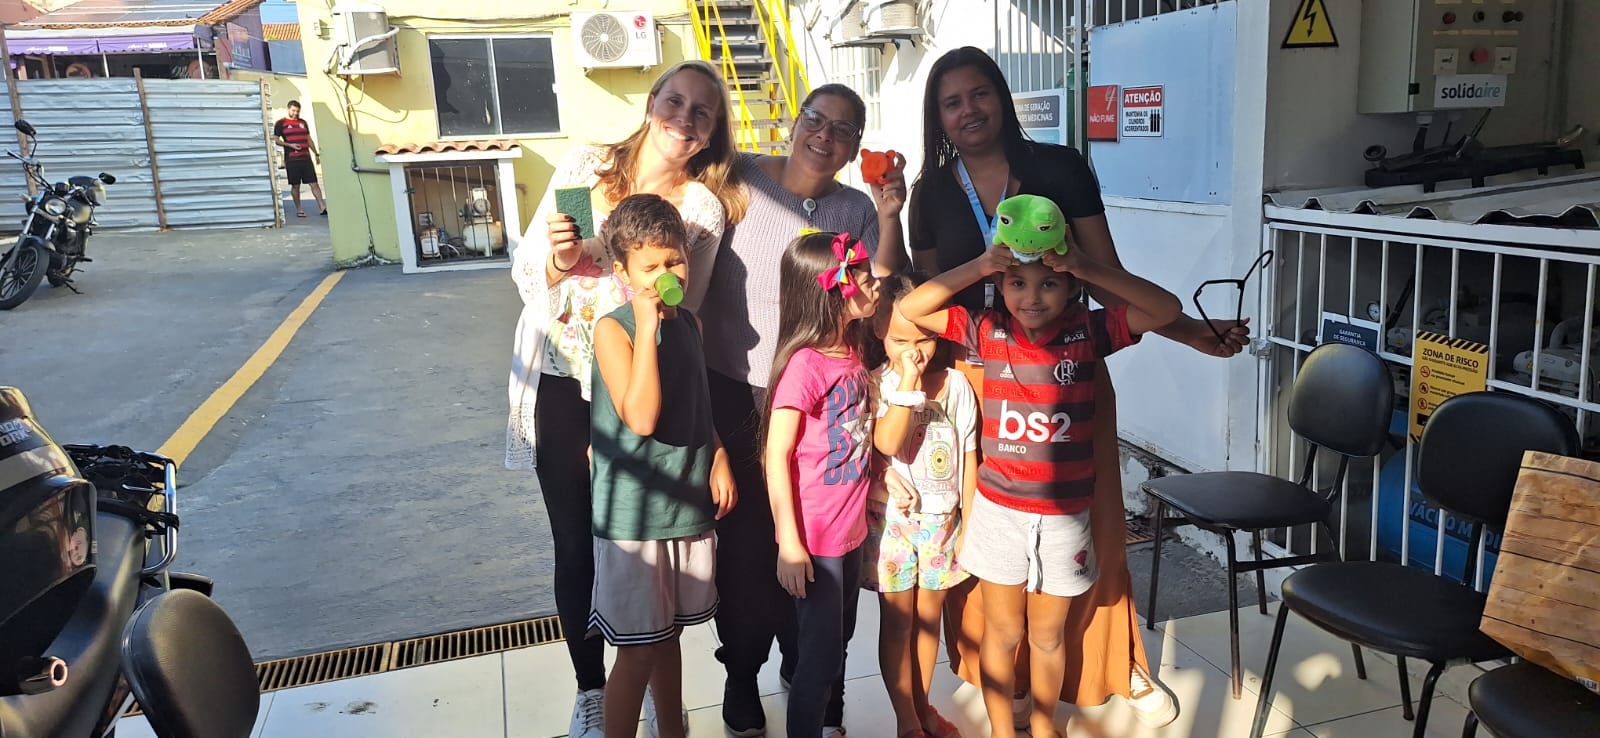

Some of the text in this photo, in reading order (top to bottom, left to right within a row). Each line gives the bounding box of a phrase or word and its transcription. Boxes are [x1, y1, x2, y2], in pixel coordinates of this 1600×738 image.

[635, 31, 647, 39] LG
[1441, 81, 1500, 99] solidaire
[1124, 91, 1161, 104] ATENÇÃO
[1089, 112, 1100, 122] NÃO
[1422, 348, 1444, 360] ZONA
[1444, 353, 1455, 362] DE
[1456, 356, 1479, 369] RISCO
[998, 399, 1071, 443] bs2
[998, 443, 1027, 454] BANCO
